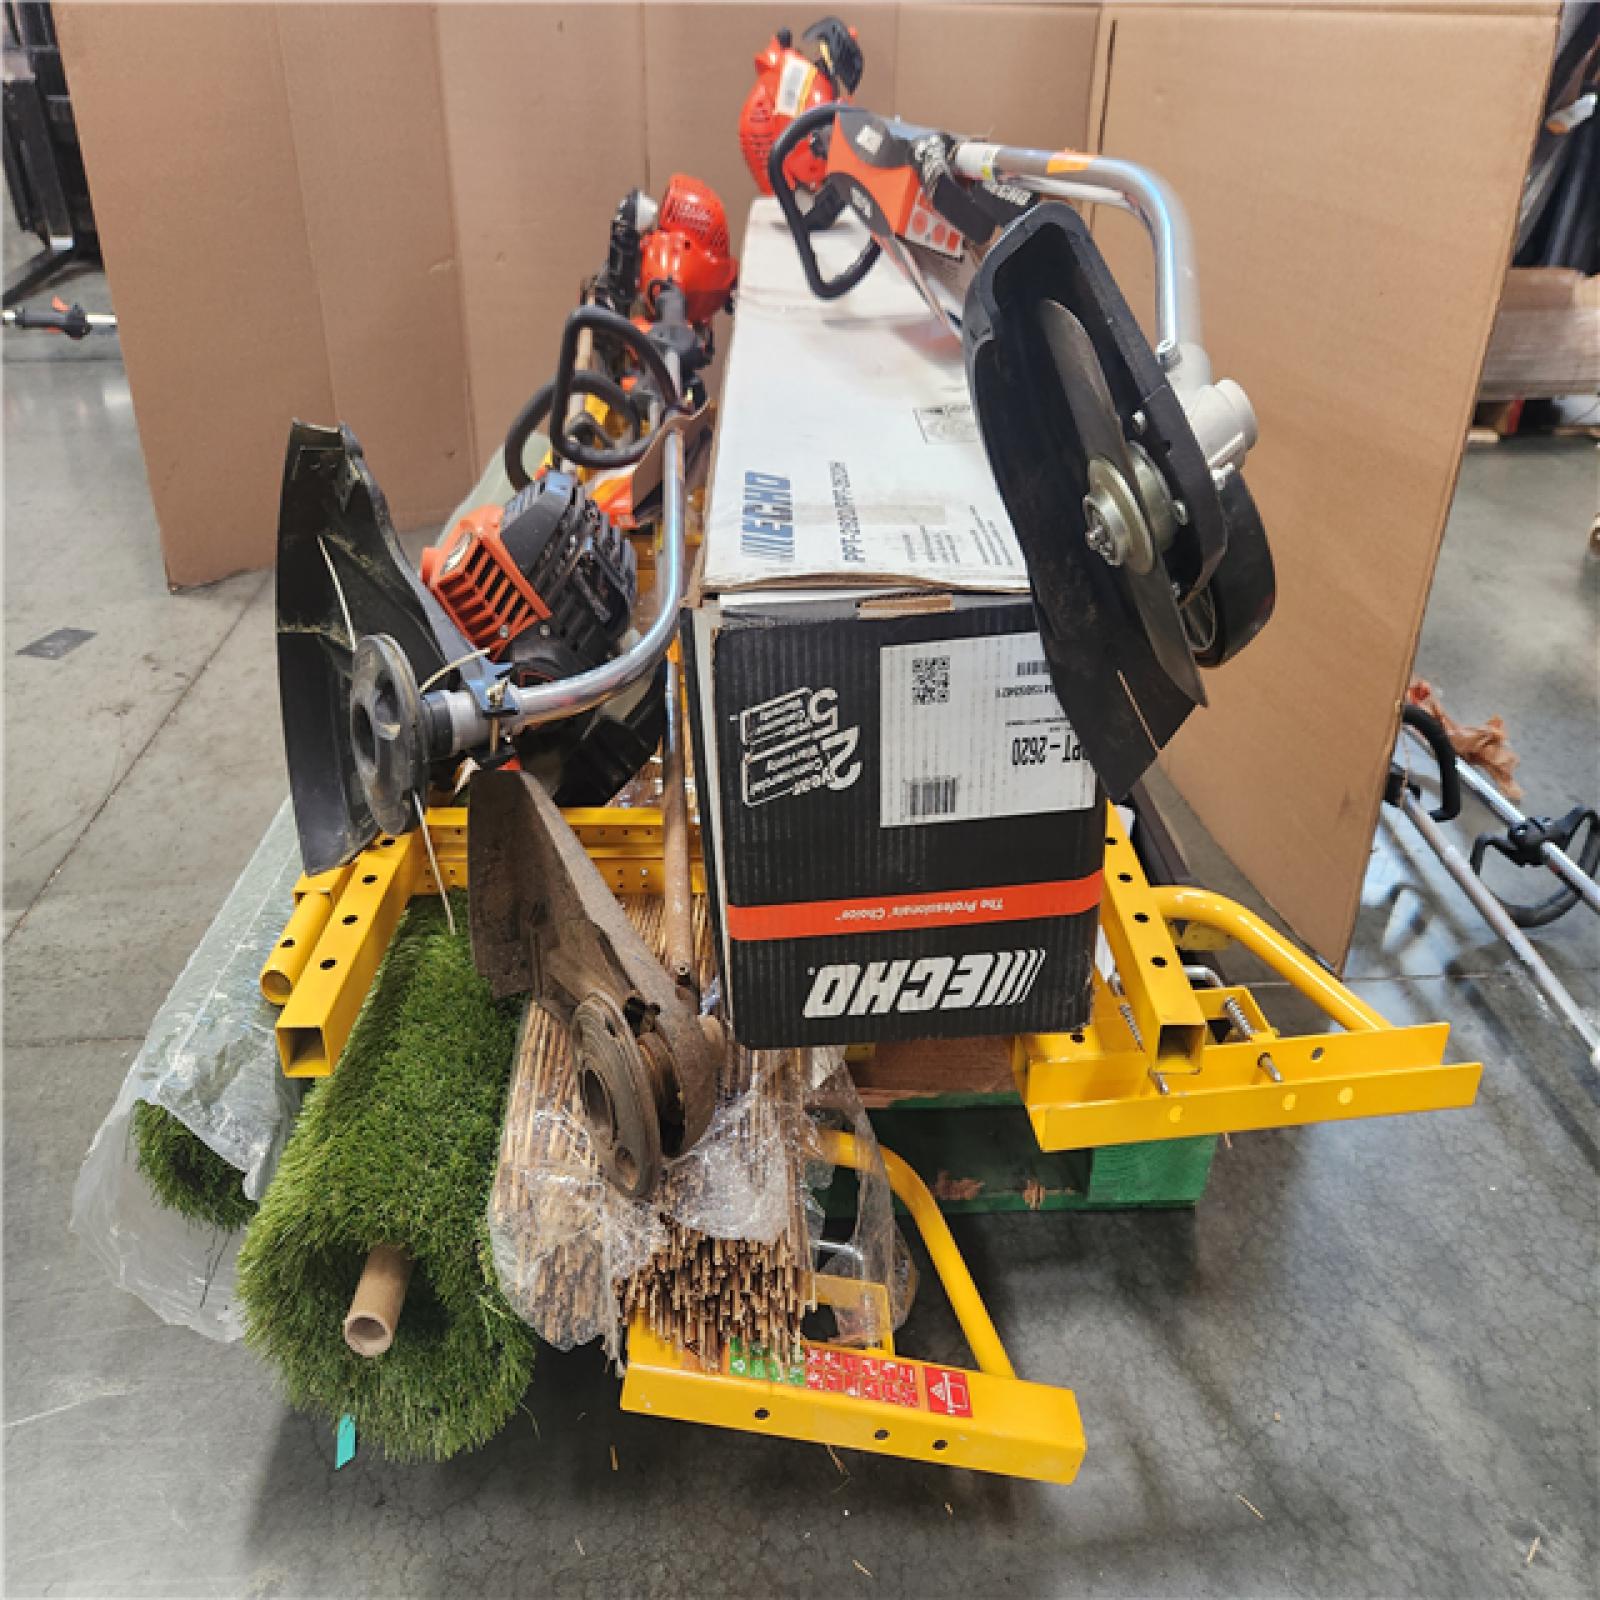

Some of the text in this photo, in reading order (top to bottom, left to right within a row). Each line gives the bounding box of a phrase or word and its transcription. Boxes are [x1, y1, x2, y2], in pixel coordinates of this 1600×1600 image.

[741, 471, 793, 540] ECHO
[809, 687, 838, 723] 5
[822, 724, 862, 791] 2
[1011, 735, 1087, 766] PT-2620
[979, 898, 1004, 911] The
[802, 953, 996, 1018] ECHO
